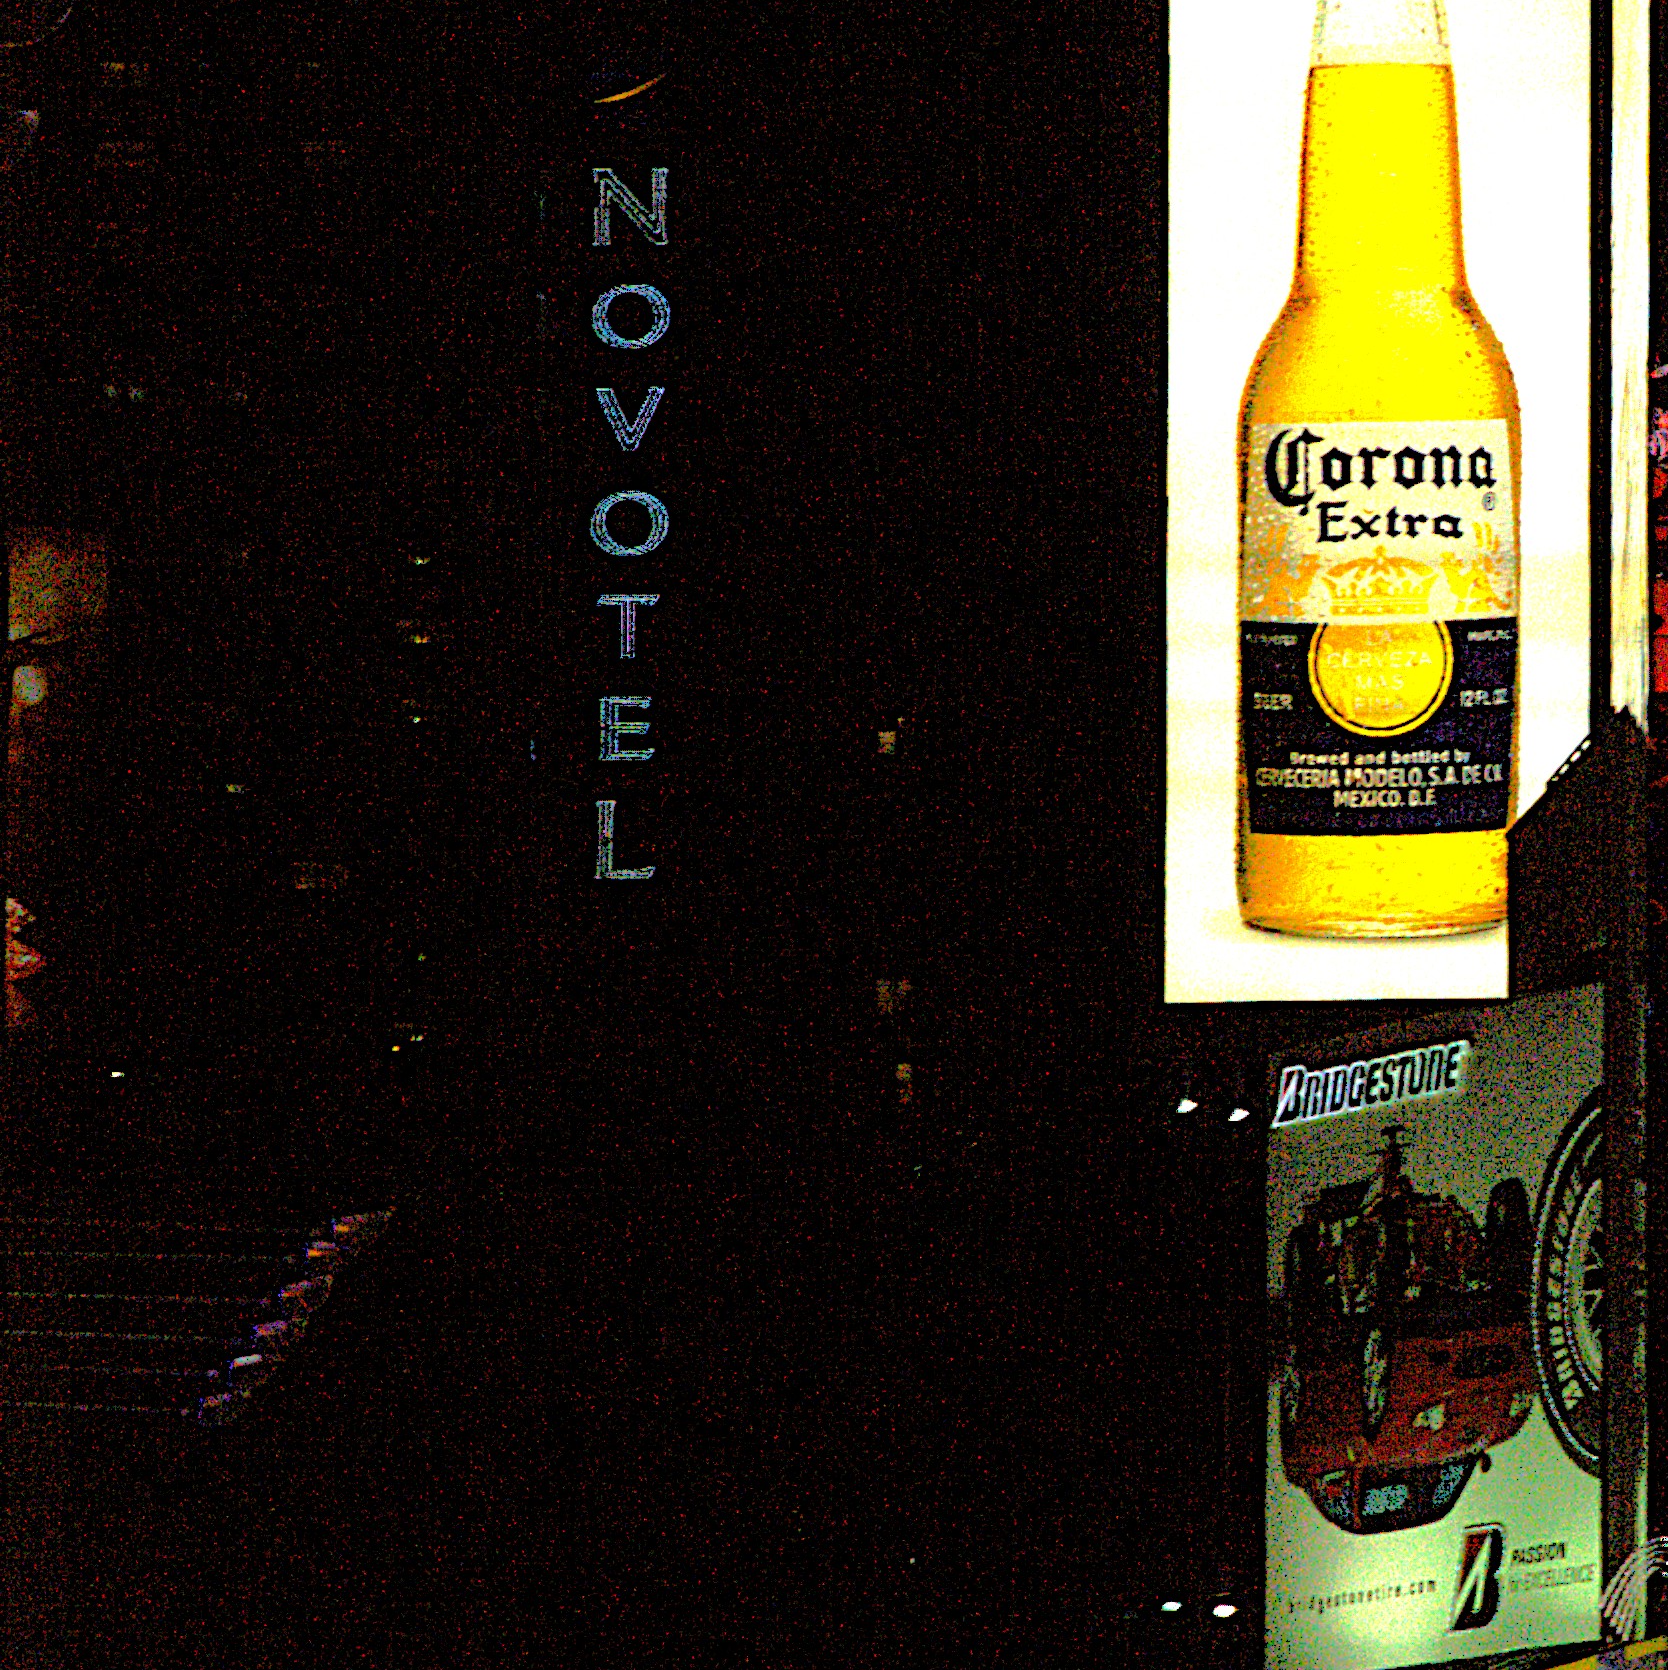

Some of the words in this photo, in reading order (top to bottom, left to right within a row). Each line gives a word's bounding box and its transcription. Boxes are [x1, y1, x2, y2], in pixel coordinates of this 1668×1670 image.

[1264, 428, 1498, 516] Corona
[591, 167, 670, 880] NOVOTEL
[1316, 499, 1464, 544] Extra
[1328, 651, 1432, 668] CERVEZA
[1354, 751, 1386, 764] and
[1273, 1042, 1470, 1126] BRIDGESTONE
